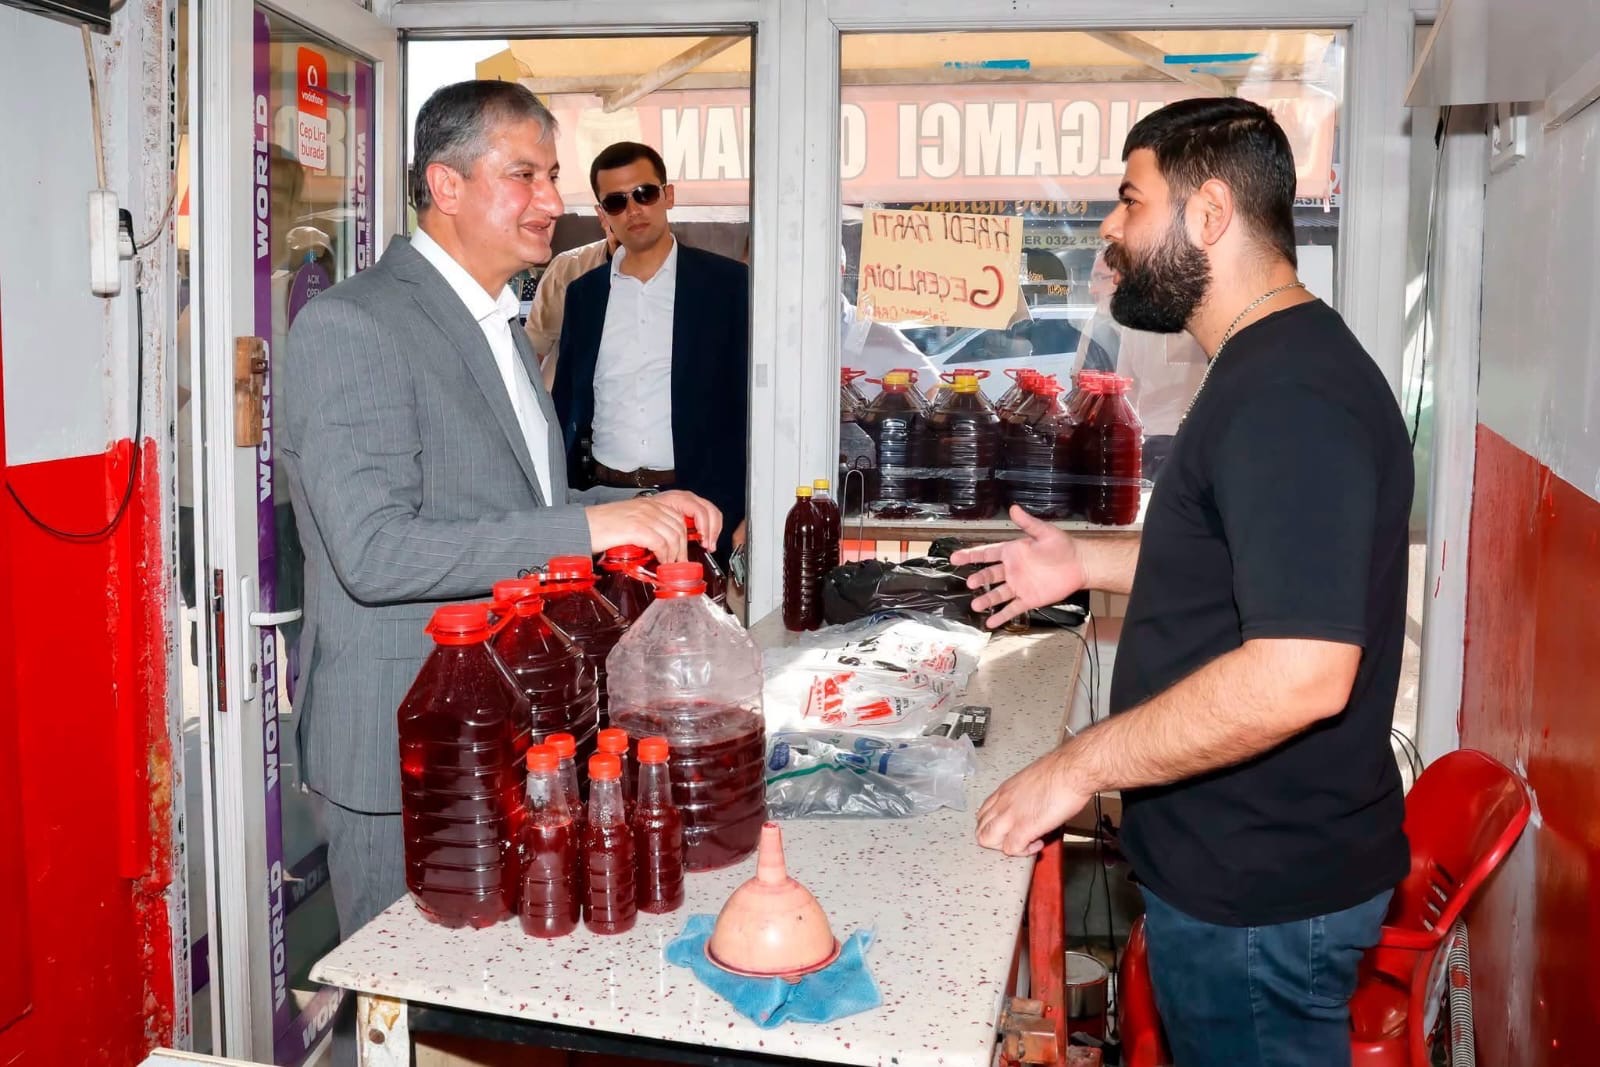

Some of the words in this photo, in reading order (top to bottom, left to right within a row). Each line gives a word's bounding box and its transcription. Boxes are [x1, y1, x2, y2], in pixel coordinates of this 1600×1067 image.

[299, 121, 313, 141] Cep
[313, 124, 326, 143] Lira
[301, 90, 324, 106] vodafone
[256, 94, 269, 260] WORLD
[301, 143, 325, 160] burada
[357, 132, 367, 270] WORLD
[1046, 235, 1076, 246] 0322
[263, 632, 279, 793] WORLD
[270, 860, 286, 1011] WORLD
